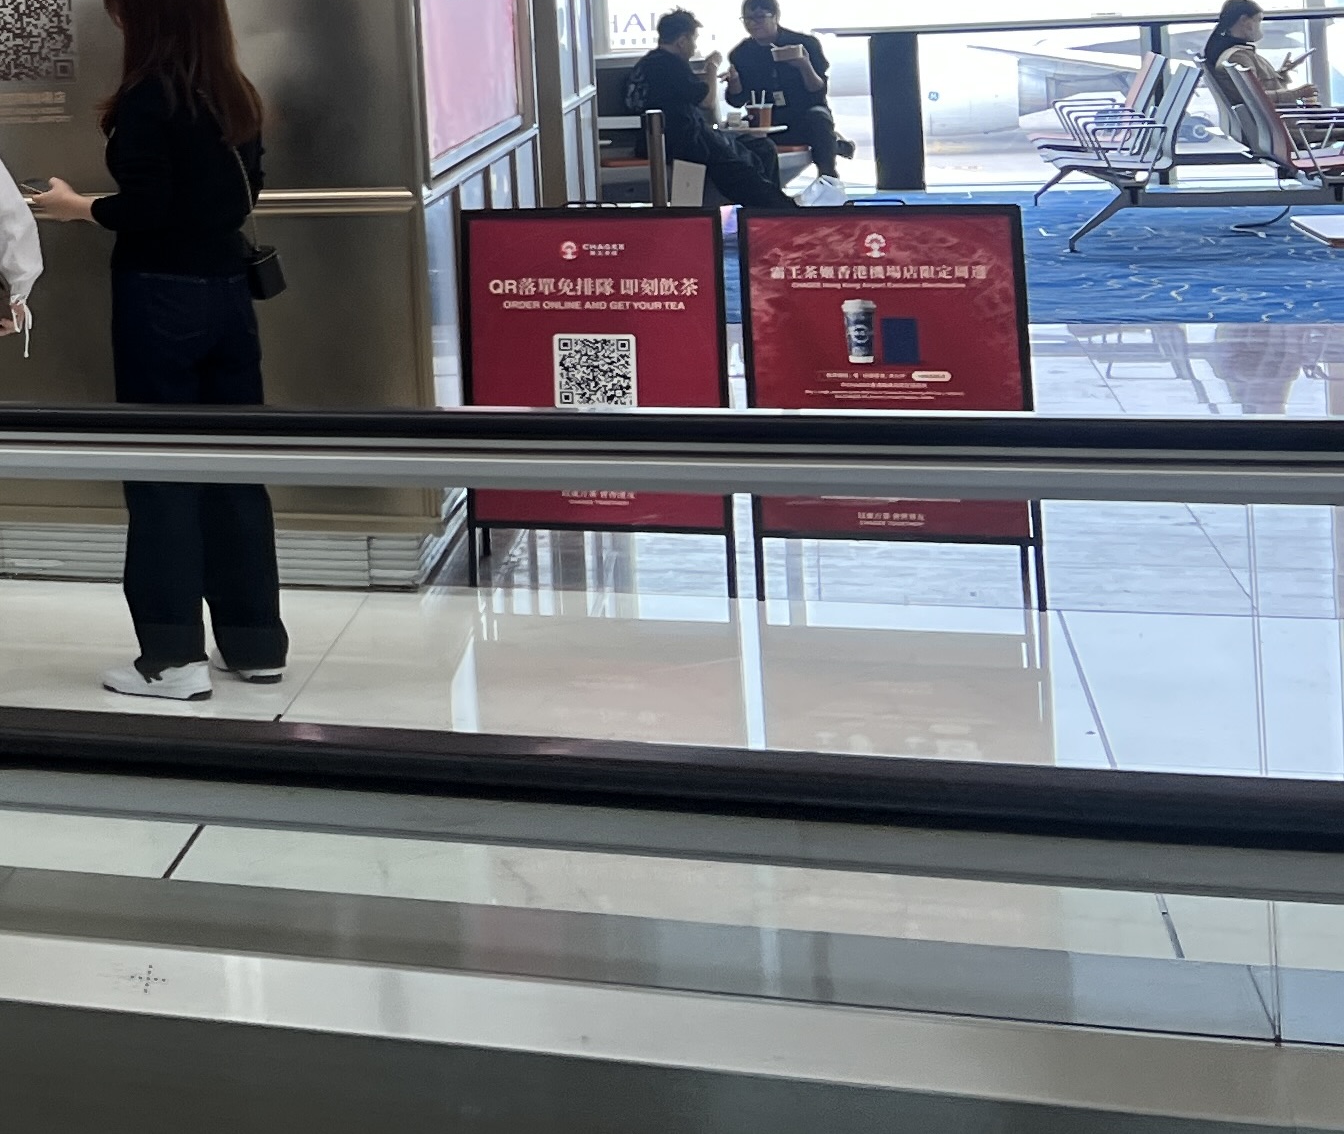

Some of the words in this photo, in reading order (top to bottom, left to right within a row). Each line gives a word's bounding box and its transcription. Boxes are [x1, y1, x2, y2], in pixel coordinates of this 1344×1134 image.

[620, 277, 699, 296] 即刻飲茶
[502, 300, 541, 310] ORDER
[542, 300, 582, 310] ONLINE
[584, 300, 607, 310] AND
[609, 301, 630, 310] GET
[632, 301, 662, 310] YOUR
[664, 301, 686, 310] TEA
